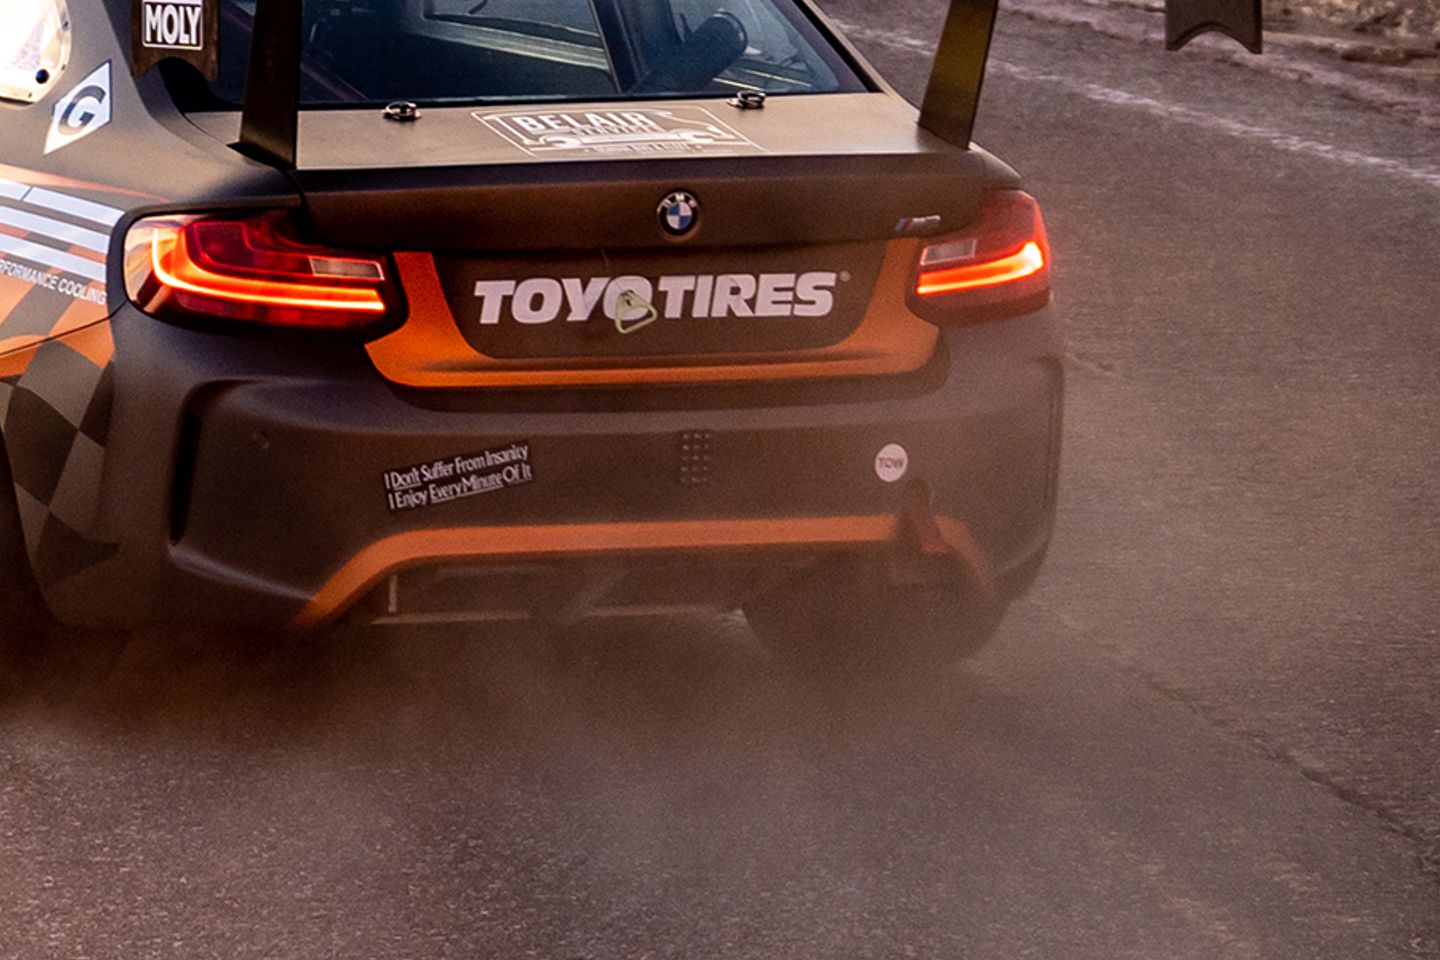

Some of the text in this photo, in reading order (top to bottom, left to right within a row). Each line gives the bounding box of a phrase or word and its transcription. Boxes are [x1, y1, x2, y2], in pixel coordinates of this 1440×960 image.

[145, 3, 201, 45] MOLY
[58, 85, 106, 136] G
[58, 277, 108, 305] COOLING
[384, 473, 391, 489] I
[420, 461, 454, 482] Suffer
[454, 456, 487, 474] From
[485, 444, 529, 467] Insanity
[388, 462, 532, 510] I Enjoy Every Minute Of It
